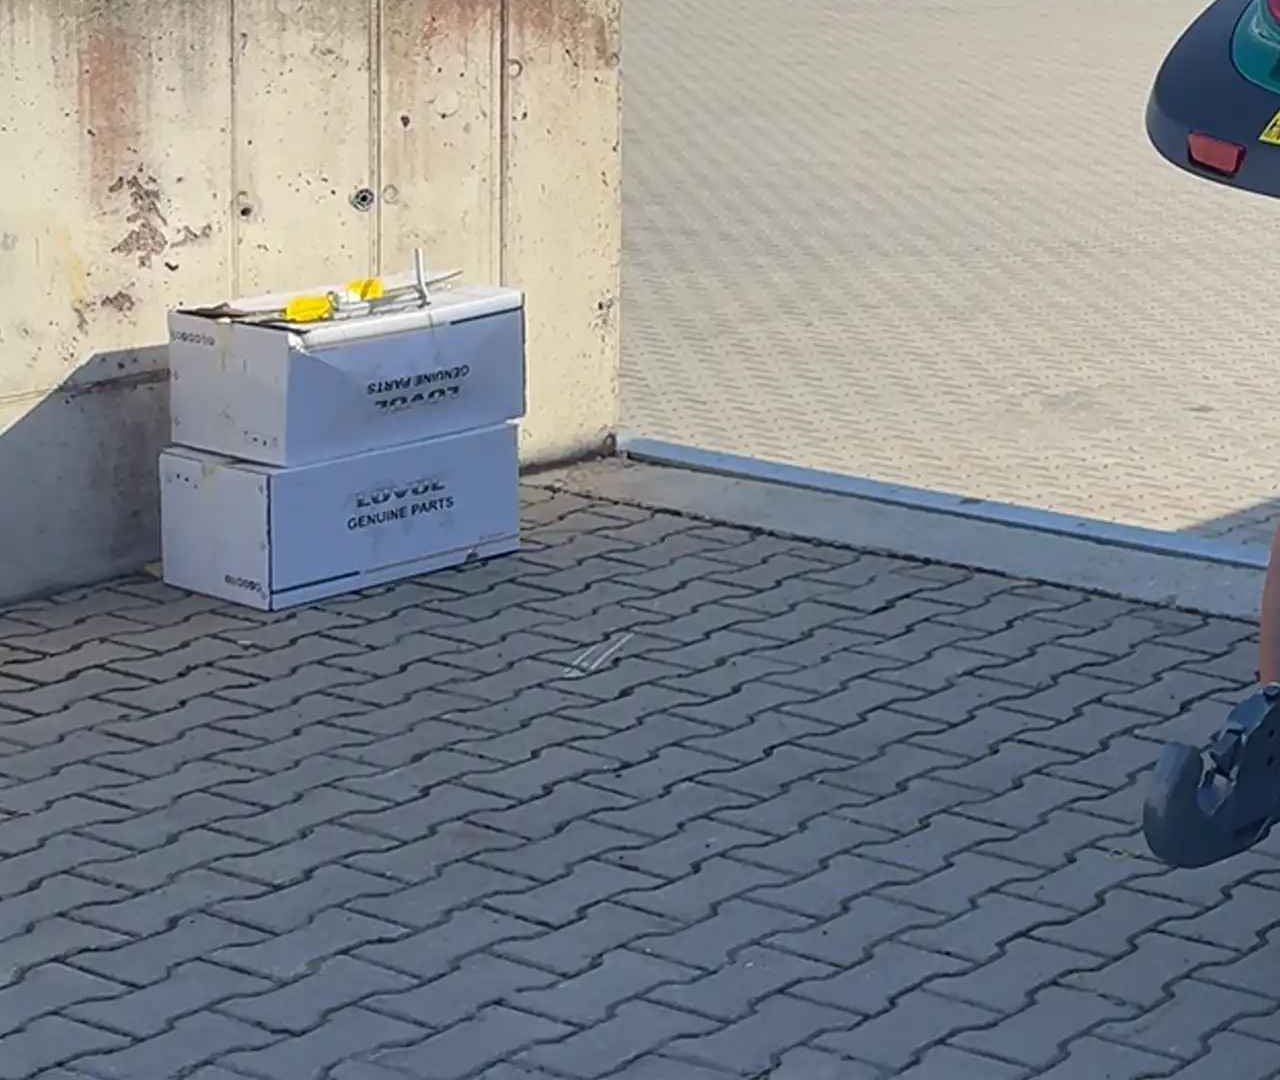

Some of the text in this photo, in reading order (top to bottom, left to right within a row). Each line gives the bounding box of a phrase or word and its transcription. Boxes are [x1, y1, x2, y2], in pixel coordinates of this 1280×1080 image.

[367, 377, 411, 395] PARTS
[347, 496, 454, 531] GENUINE PARTS
